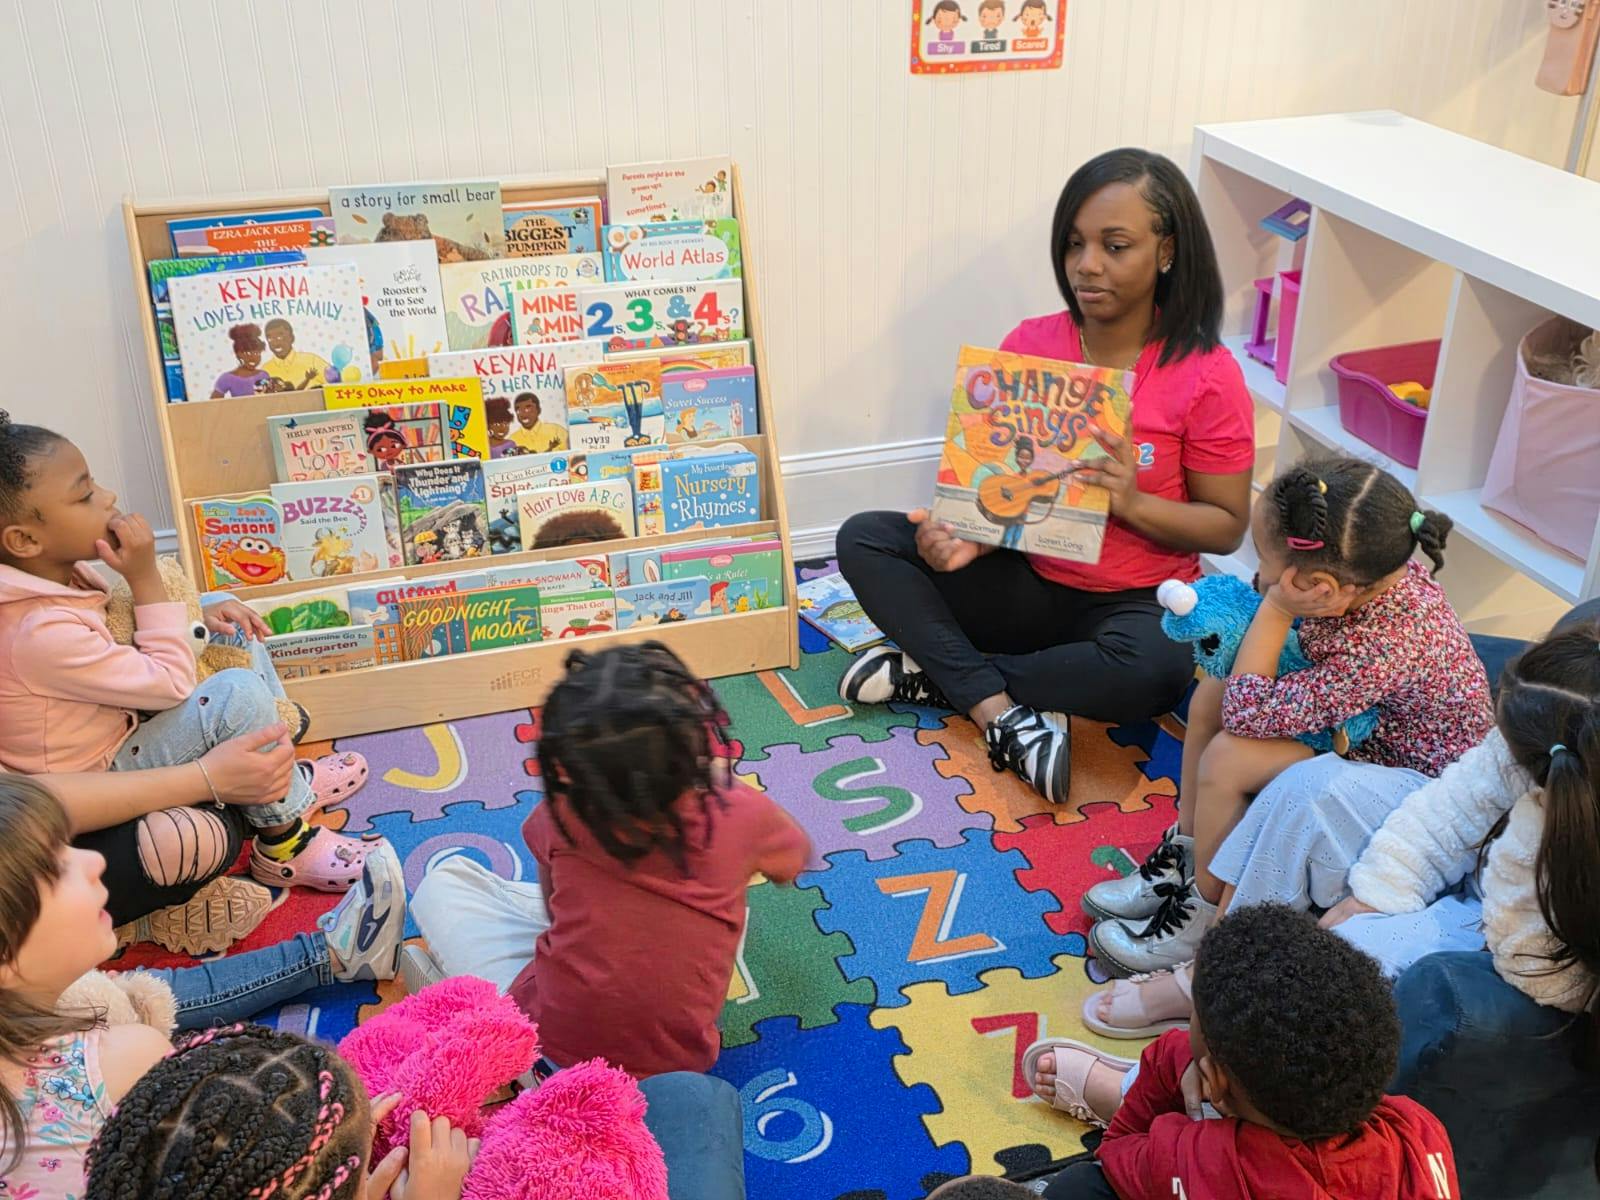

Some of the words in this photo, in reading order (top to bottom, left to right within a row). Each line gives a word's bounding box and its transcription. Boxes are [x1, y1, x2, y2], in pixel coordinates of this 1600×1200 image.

[937, 43, 954, 53] Shy
[979, 41, 1001, 51] Tired
[1015, 40, 1046, 49] Scared
[341, 198, 350, 208] a
[354, 193, 393, 209] story
[397, 192, 416, 207] for
[422, 188, 461, 205] small
[466, 188, 497, 201] bear
[213, 230, 242, 240] EZRA
[243, 227, 271, 237] JACK
[273, 224, 305, 234] KEATS
[523, 218, 547, 227] THE
[504, 225, 577, 242] BIGGEST
[254, 239, 279, 248] THE
[507, 240, 567, 253] PUMPKIN
[624, 250, 675, 270] World
[681, 248, 724, 265] Atlas
[480, 264, 551, 283] RAINDROPS
[555, 265, 569, 279] TO
[218, 274, 310, 304] KEYANA
[624, 289, 651, 299] WHAT
[653, 288, 684, 297] COMES
[686, 285, 697, 294] IN
[376, 297, 392, 307] Off
[395, 298, 405, 306] to
[407, 297, 425, 305] See
[389, 308, 406, 317] the
[407, 305, 437, 316] World
[521, 293, 578, 315] MINE
[666, 294, 692, 319] &
[193, 304, 245, 332] LOVES
[250, 299, 283, 319] HER
[287, 299, 344, 321] FAMILY
[544, 314, 584, 334] MIN
[473, 352, 557, 376] KEYANA
[335, 388, 364, 400] It's
[367, 386, 405, 399] Okay
[408, 385, 425, 396] to
[429, 382, 468, 394] Make
[501, 374, 532, 393] HER
[286, 429, 312, 439] HELP
[313, 424, 354, 435] WANTED
[988, 405, 1088, 453] Sings
[290, 434, 357, 457] MUST
[298, 451, 357, 471] LOVE
[409, 475, 450, 488] Thunder
[451, 471, 470, 483] and
[415, 468, 434, 478] Why
[674, 473, 747, 498] Nursery
[522, 496, 554, 519] Hair
[556, 488, 586, 506] Love
[678, 496, 746, 522] Rhymes
[205, 517, 276, 535] Seasons
[535, 572, 582, 585] SNOWMAN
[633, 591, 655, 602] Jack
[658, 592, 676, 601] and
[677, 590, 693, 601] Jill
[403, 598, 517, 628] GOODNIGHT
[541, 605, 565, 615] ings
[567, 602, 587, 611] That
[304, 634, 341, 644] Jasmine
[342, 632, 356, 640] Go
[471, 619, 530, 641] MOON
[270, 640, 358, 659] Kindergarten
[812, 755, 923, 835] S
[876, 870, 1005, 965] Z
[740, 1067, 833, 1163] 6
